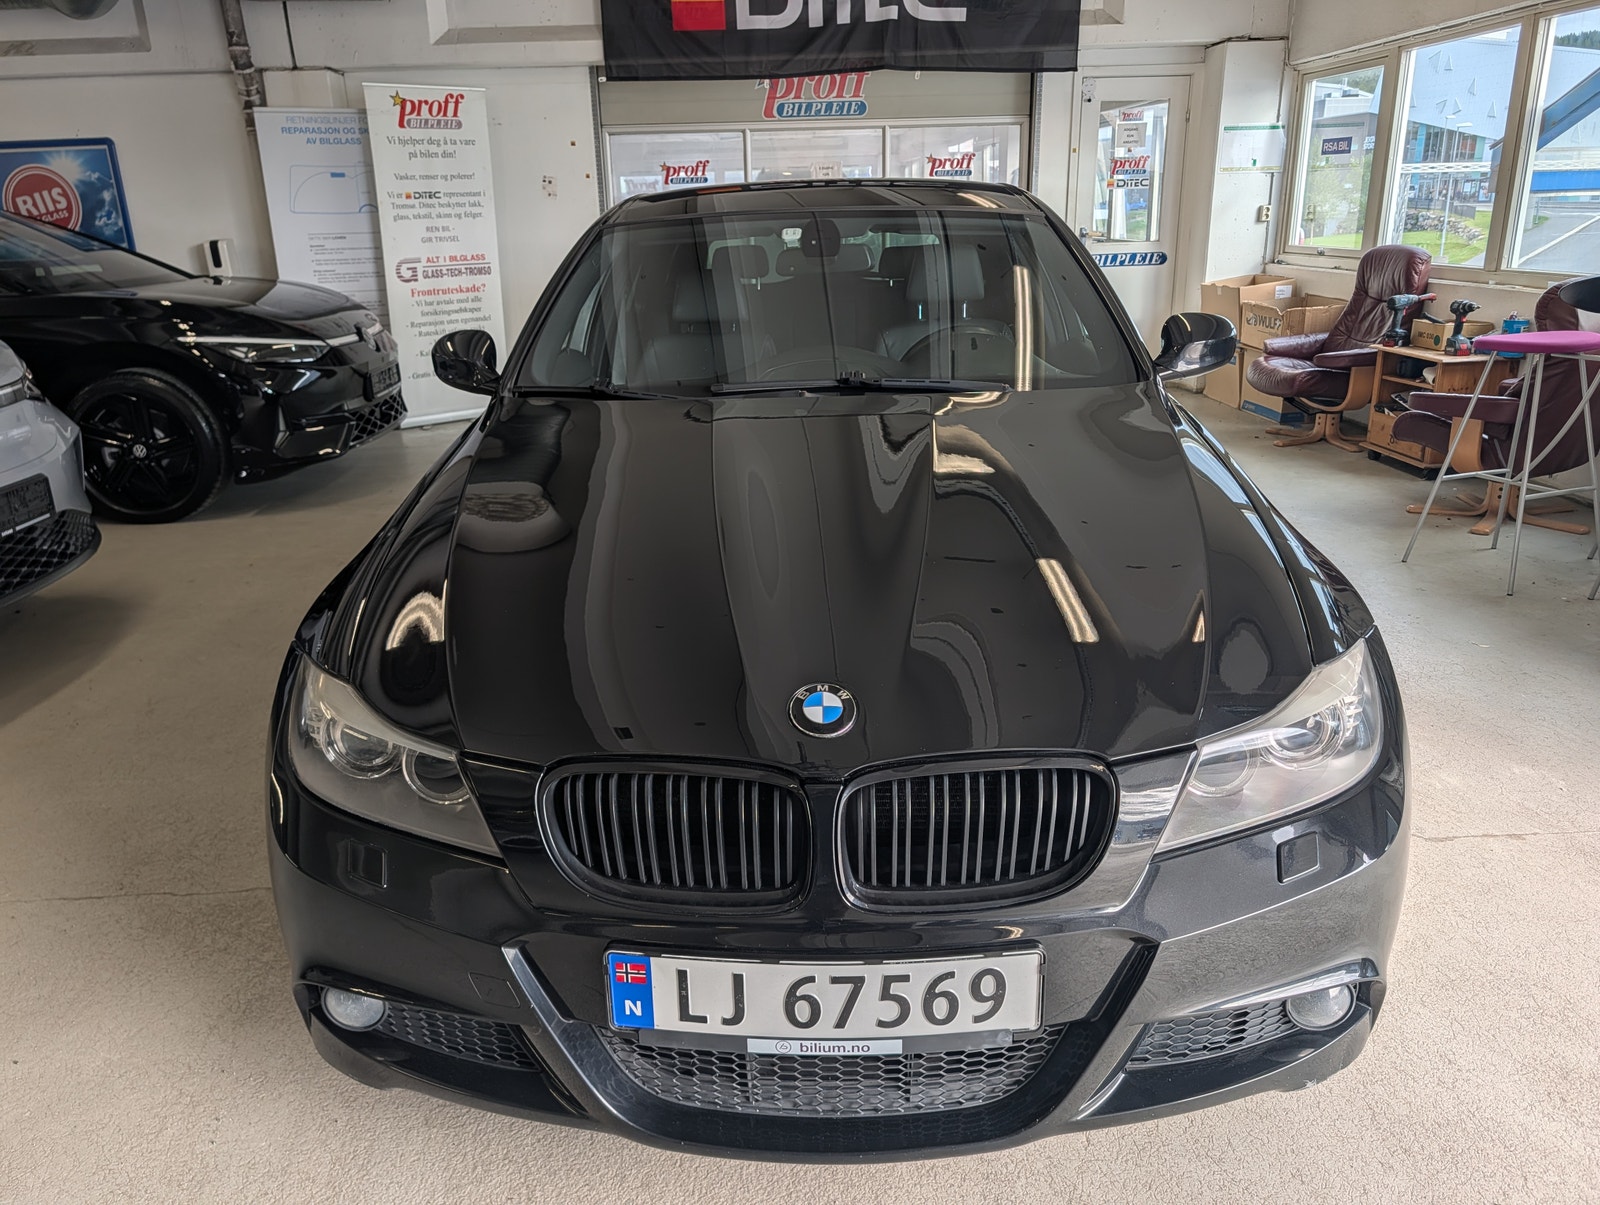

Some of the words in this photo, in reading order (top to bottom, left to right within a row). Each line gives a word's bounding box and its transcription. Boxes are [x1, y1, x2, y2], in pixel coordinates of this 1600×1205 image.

[763, 70, 871, 119] proff
[398, 93, 465, 129] proff
[782, 102, 862, 116] BILPLEIE
[286, 116, 356, 124] RETNINGSLINJER
[410, 119, 459, 128] BILPLEIE
[387, 136, 396, 145] Vi
[398, 137, 425, 147] hjelper
[427, 137, 441, 147] deg
[443, 137, 448, 146] å
[1323, 142, 1338, 152] RSA
[1339, 141, 1349, 151] BIL
[408, 151, 418, 160] på
[420, 150, 439, 158] bilen
[441, 150, 457, 159] din!
[927, 153, 976, 177] proff
[1111, 156, 1150, 175] proff
[394, 172, 418, 181] Vasker,
[450, 172, 475, 181] polerer!
[664, 160, 710, 185] proff
[443, 190, 482, 199] representant
[15, 187, 68, 218] RIIS
[438, 201, 467, 210] beskytter
[468, 200, 484, 208] lakk,
[393, 213, 411, 223] glass,
[412, 212, 434, 220] tekstil,
[454, 212, 463, 220] og
[464, 211, 483, 219] felger.
[426, 256, 440, 264] ALT
[449, 254, 486, 262] BILGLASS
[1093, 252, 1162, 267] BILPLEIE
[410, 284, 486, 298] Frontruteskade?
[410, 319, 445, 329] Reparasjon
[1258, 314, 1282, 331] WULF
[797, 685, 850, 700] BMW
[677, 967, 746, 1027] LJ
[784, 967, 1008, 1031] 67569
[624, 999, 643, 1017] N
[799, 1042, 871, 1054] bilium.no
